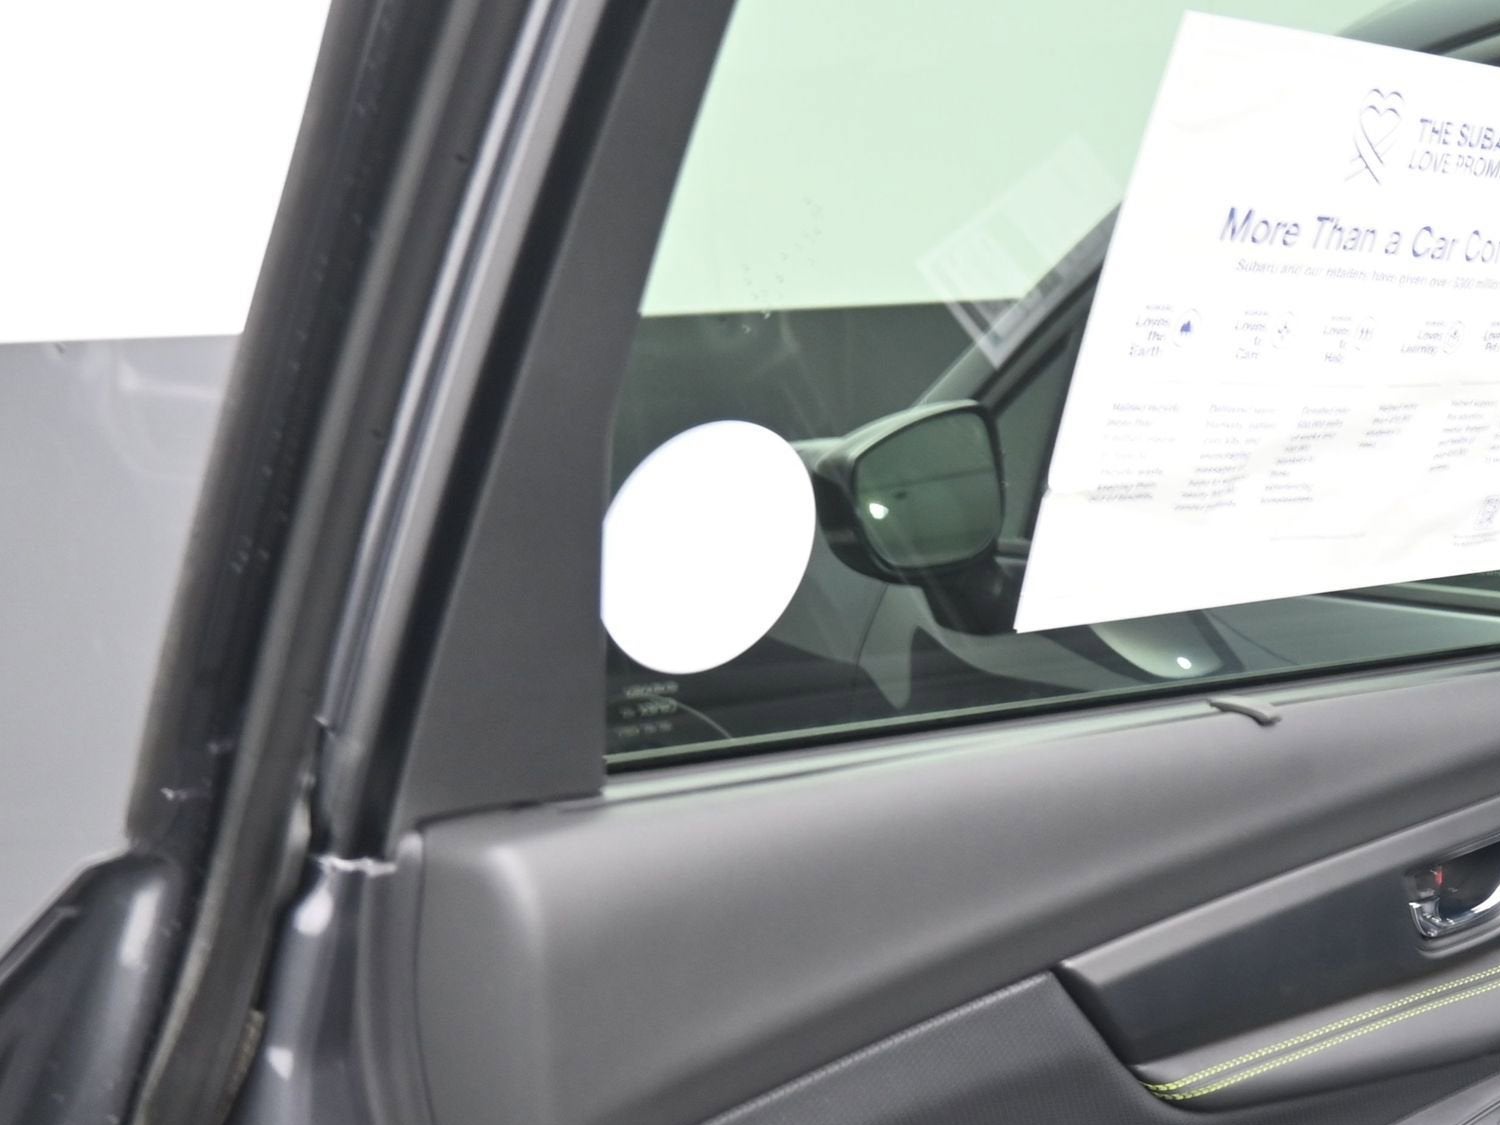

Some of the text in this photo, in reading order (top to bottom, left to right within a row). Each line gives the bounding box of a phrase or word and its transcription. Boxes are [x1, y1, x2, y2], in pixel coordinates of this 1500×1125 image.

[1419, 118, 1452, 145] THE
[1408, 149, 1450, 173] LOVE
[1220, 206, 1300, 247] More
[1312, 216, 1376, 253] Than
[1384, 231, 1401, 255] a
[1411, 226, 1457, 260] Car
